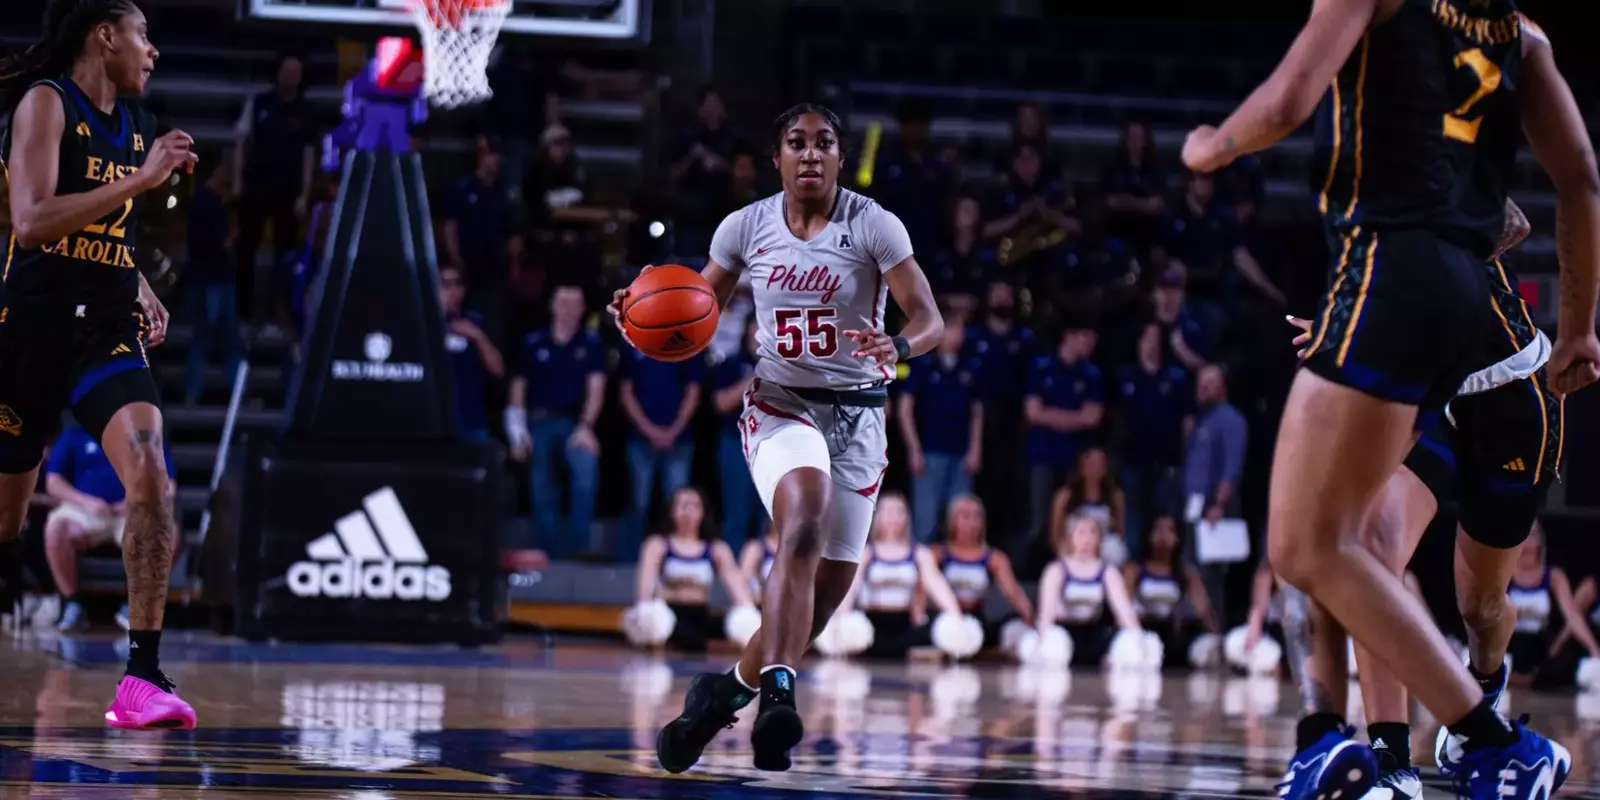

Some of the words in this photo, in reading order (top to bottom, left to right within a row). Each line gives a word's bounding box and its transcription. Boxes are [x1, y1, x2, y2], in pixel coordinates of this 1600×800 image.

[1442, 47, 1502, 144] 2
[838, 233, 852, 250] A
[766, 264, 842, 305] Philly
[773, 307, 839, 360] 55
[285, 555, 452, 602] adidas
